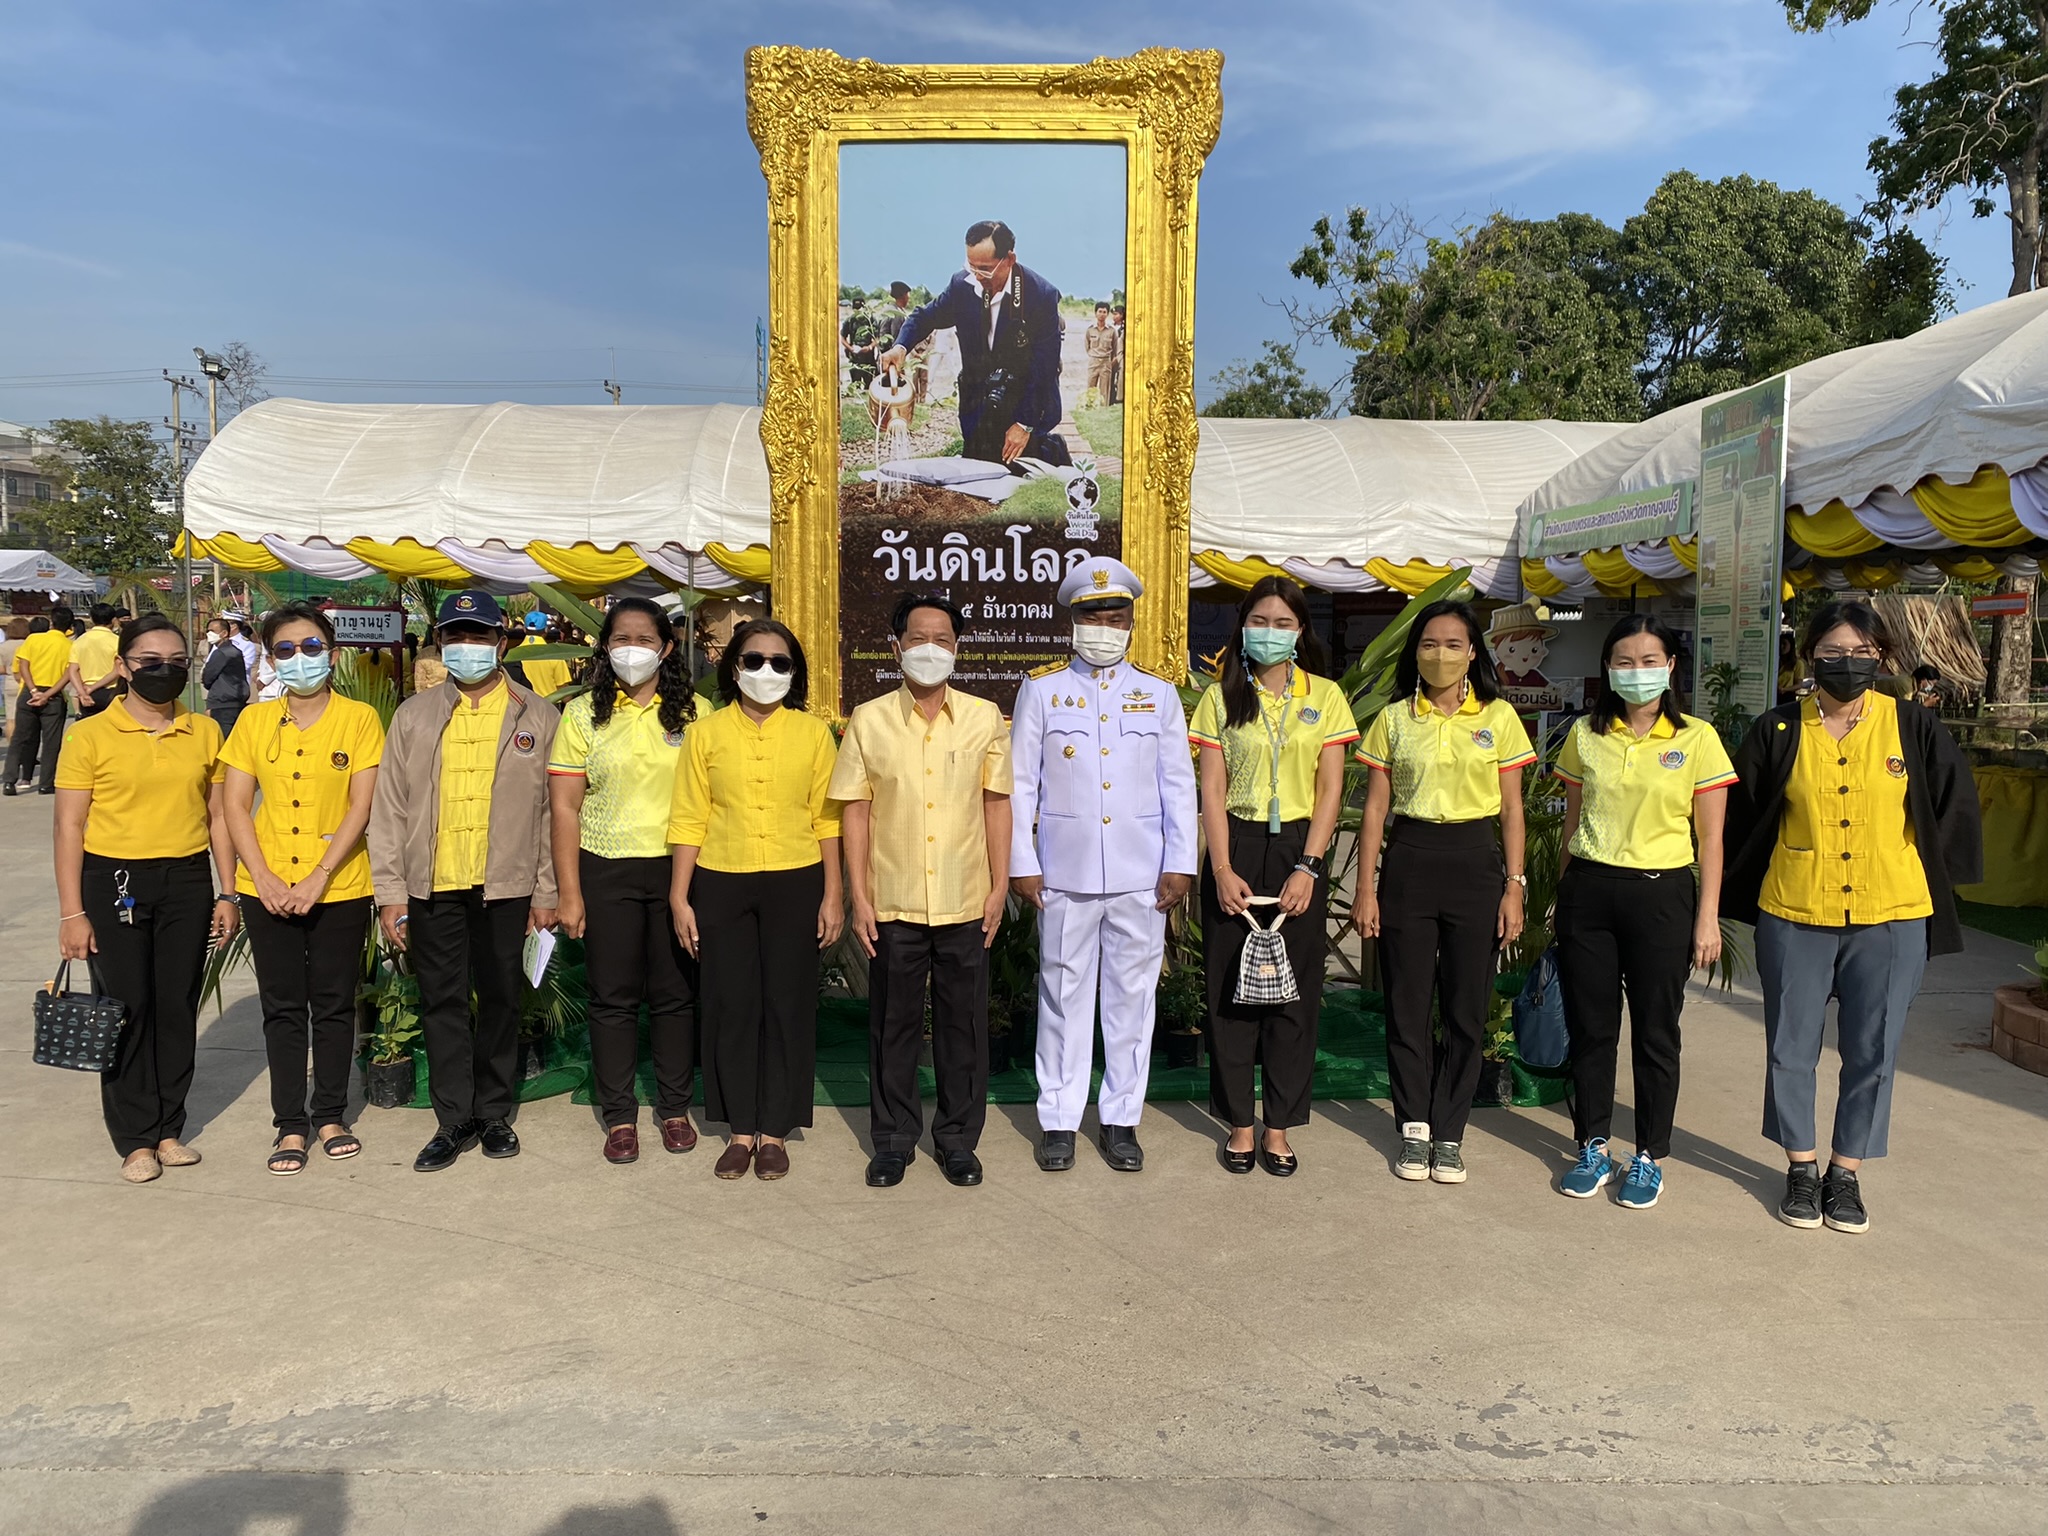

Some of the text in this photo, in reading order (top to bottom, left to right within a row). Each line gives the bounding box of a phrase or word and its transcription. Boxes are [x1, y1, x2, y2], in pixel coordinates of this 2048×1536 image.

[1012, 276, 1021, 308] Canon
[1071, 520, 1093, 529] World
[1066, 529, 1097, 539] Soil Day
[961, 595, 1053, 618] ๕ ธันวาคม
[333, 613, 391, 632] กาญจนบุรี
[336, 632, 385, 640] KANCHANABURI
[1018, 635, 1023, 643] 5
[1025, 632, 1050, 643] ธันวาคม
